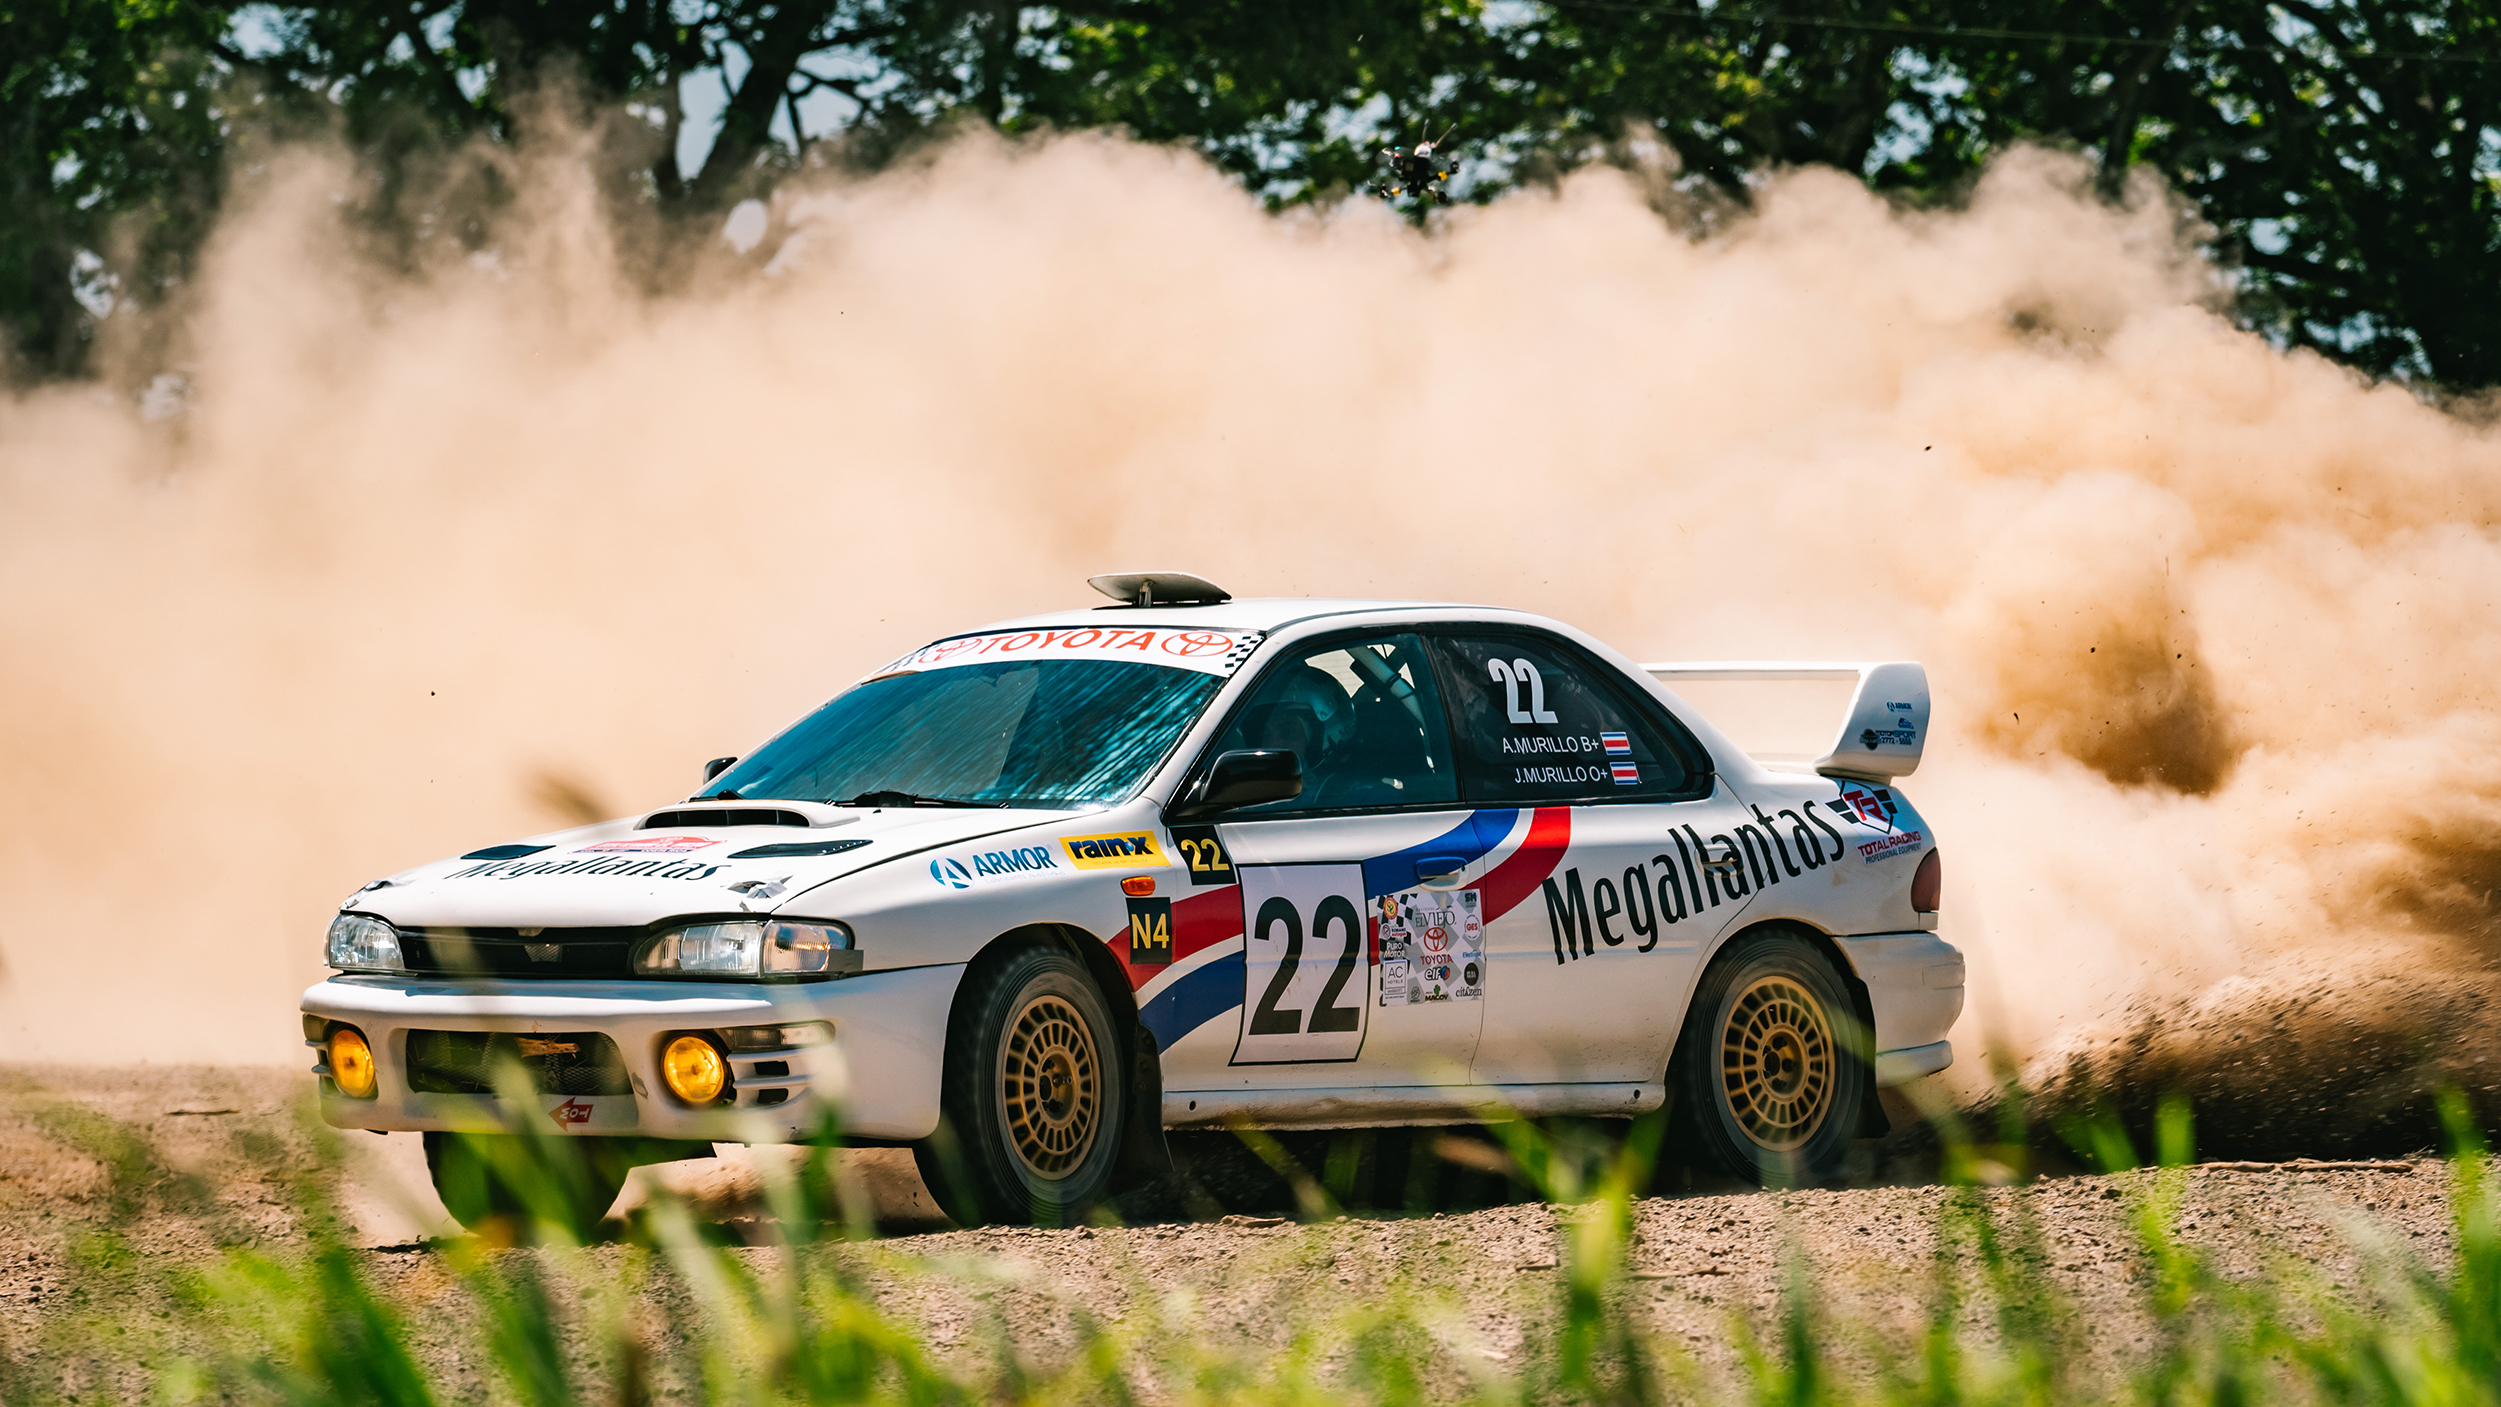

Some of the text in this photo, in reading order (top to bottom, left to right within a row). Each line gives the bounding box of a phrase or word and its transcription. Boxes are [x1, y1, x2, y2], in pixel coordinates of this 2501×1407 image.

[978, 629, 1157, 655] TOYOTA
[1487, 657, 1559, 724] 22
[1502, 736, 1599, 754] A.MURILLO B+
[1515, 766, 1608, 784] J.MURILLO O+
[1181, 838, 1230, 872] 22
[1857, 830, 1922, 857] TOTAL RACING
[1865, 842, 1921, 865] PROFESSIONAL EQUIPMENT
[443, 856, 732, 880] Megallantas
[973, 846, 1058, 876] ARMOR
[984, 874, 1027, 884] Lubricants
[1541, 800, 1845, 966] Megallantas
[1131, 913, 1170, 949] N4
[1467, 923, 1478, 931] GES
[1387, 942, 1402, 950] PURO
[1248, 895, 1361, 1035] 22
[1420, 954, 1453, 965] TOYOTA
[1388, 966, 1403, 978] AC
[559, 1107, 590, 1120] TOW
